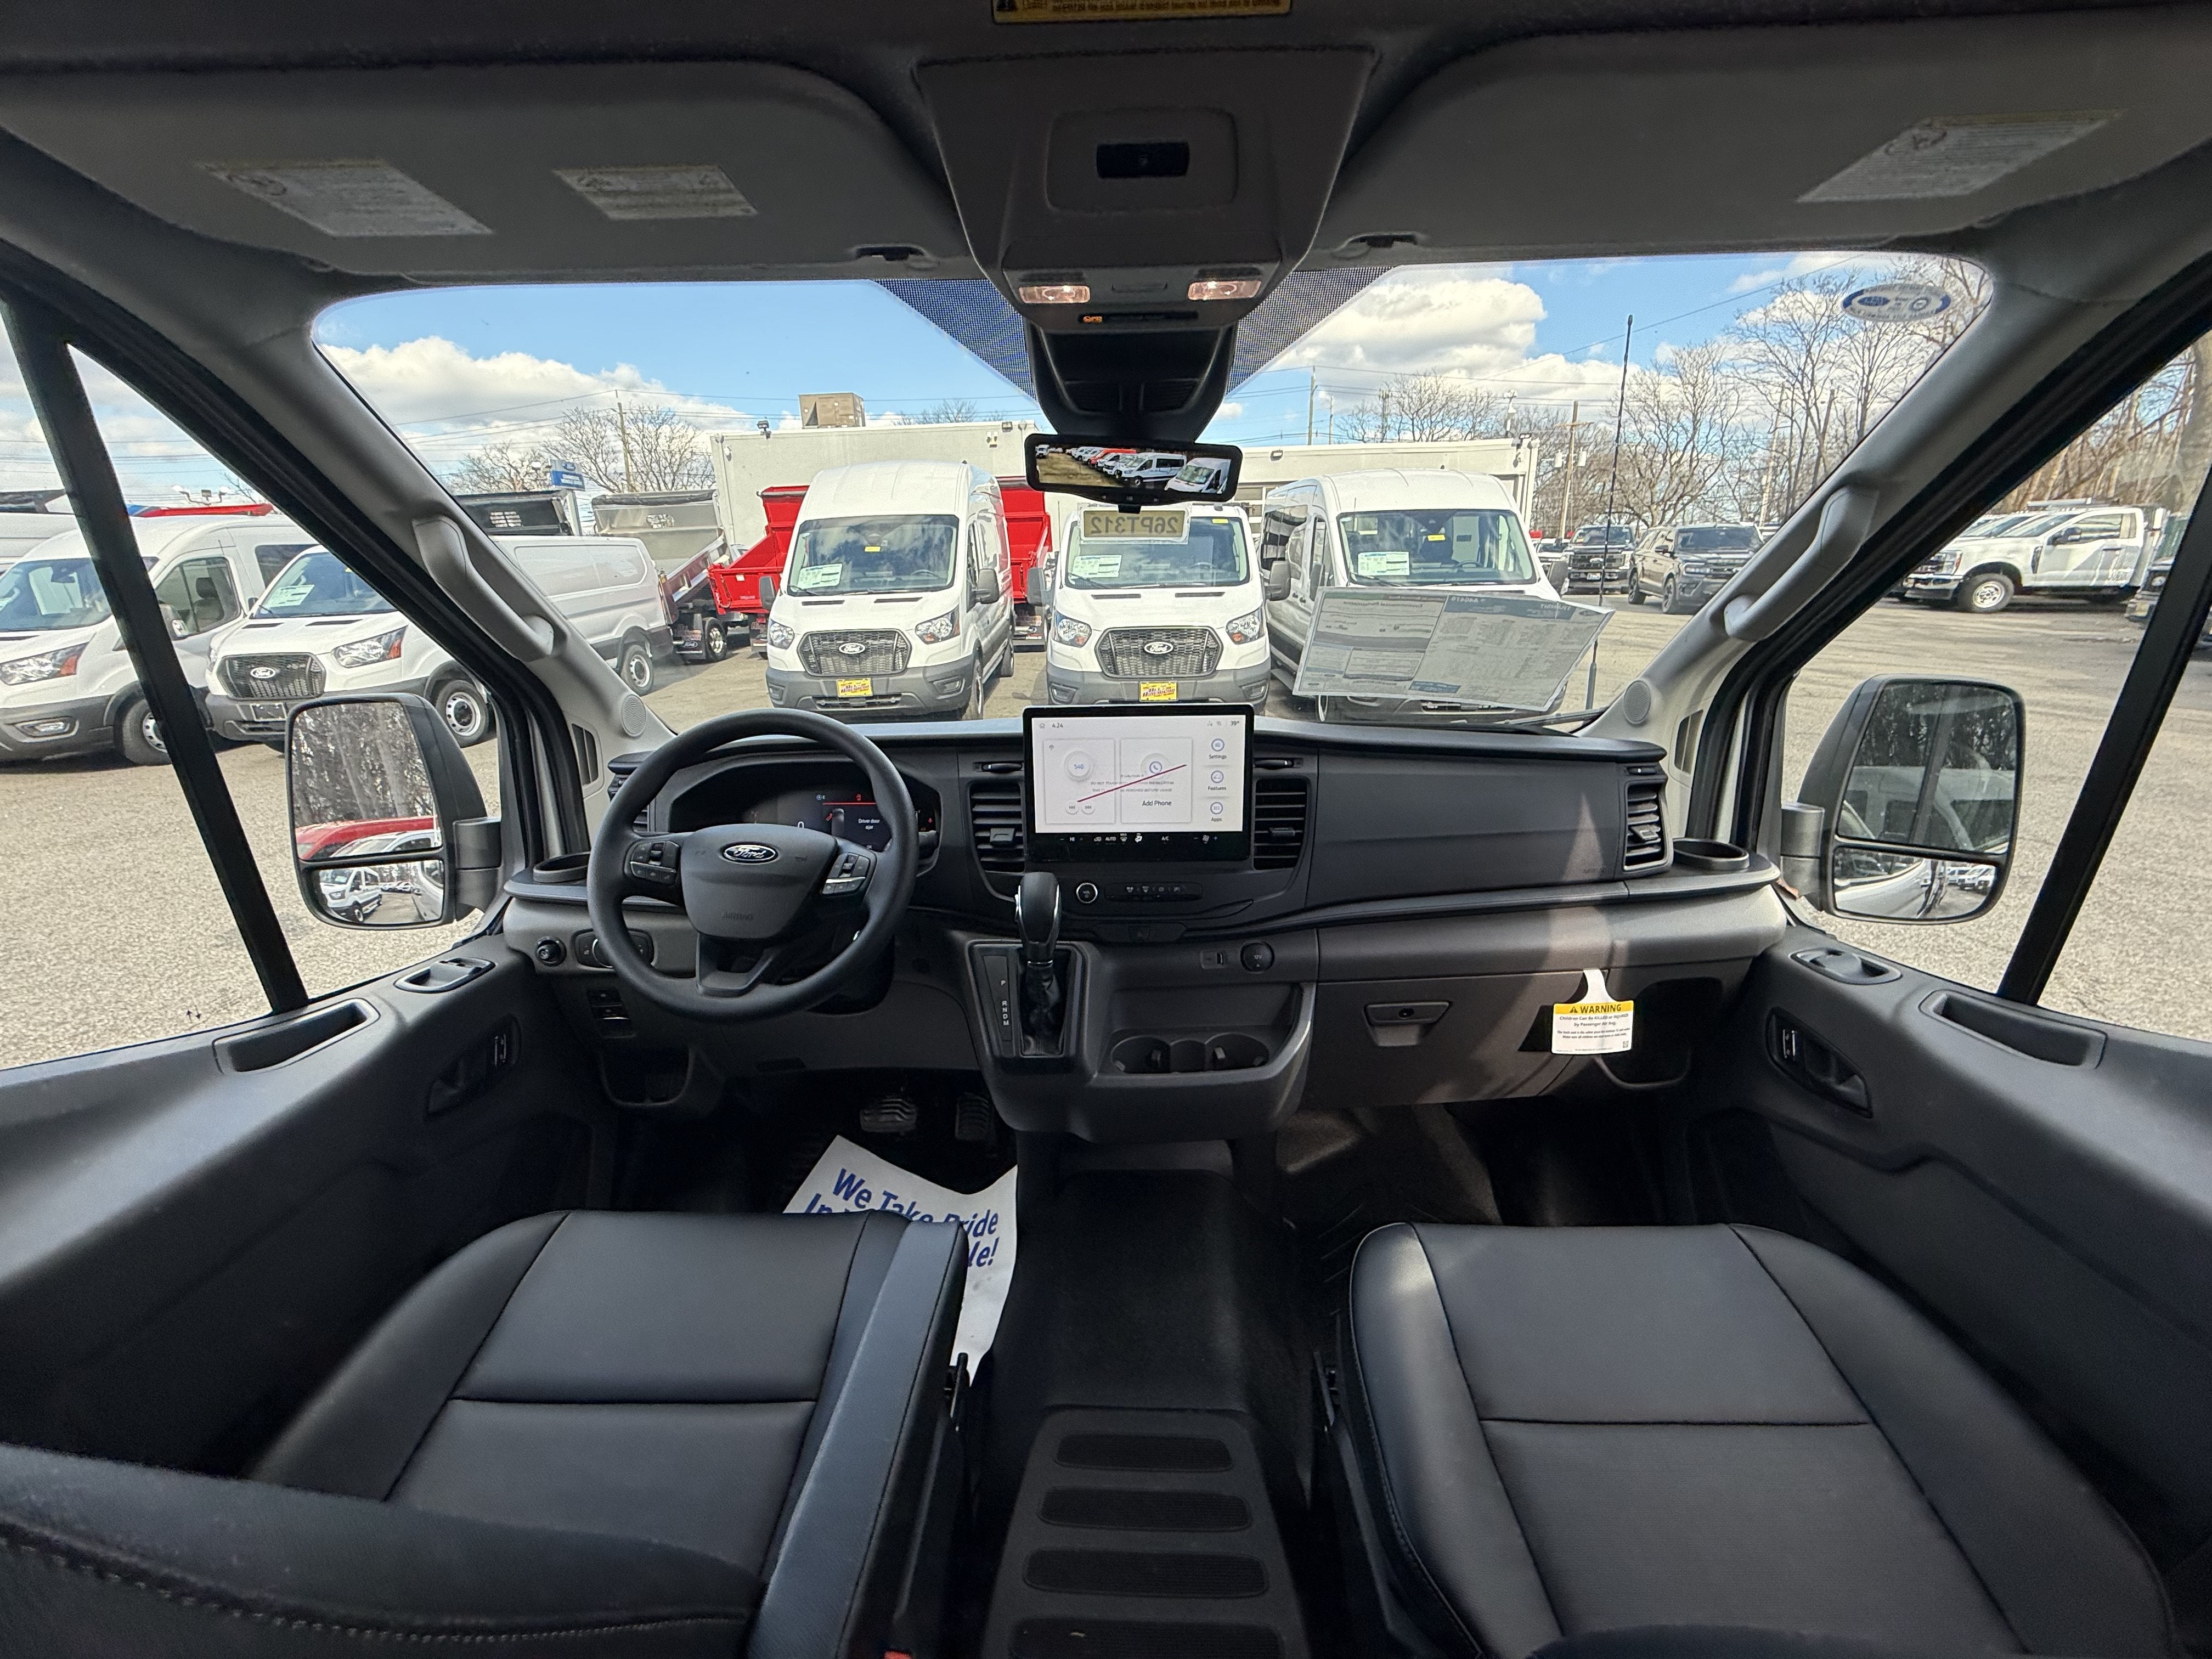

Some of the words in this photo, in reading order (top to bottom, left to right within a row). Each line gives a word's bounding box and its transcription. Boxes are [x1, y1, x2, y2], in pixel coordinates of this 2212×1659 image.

[1149, 644, 1168, 652] Ford
[733, 846, 767, 859] Ford
[1579, 1004, 1622, 1014] WARNING
[833, 1167, 872, 1209] We
